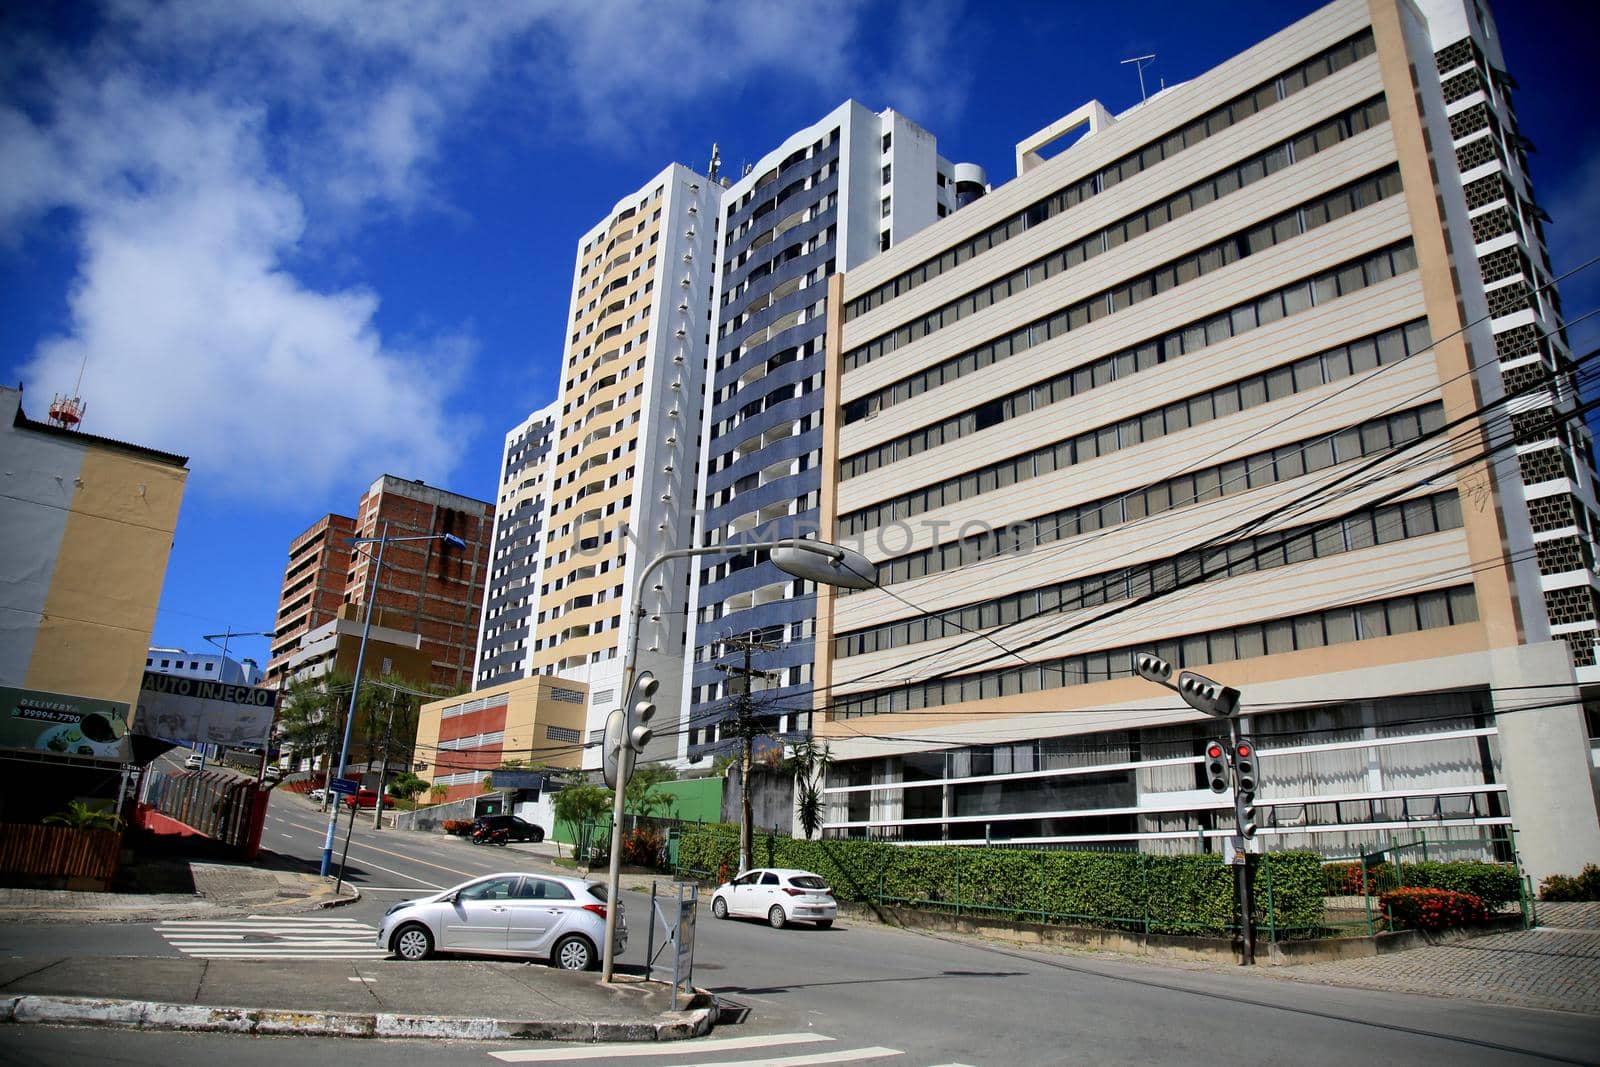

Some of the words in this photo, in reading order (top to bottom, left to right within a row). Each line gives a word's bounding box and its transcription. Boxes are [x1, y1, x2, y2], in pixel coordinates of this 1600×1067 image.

[144, 675, 191, 695] AUTO
[21, 699, 73, 711] DELIVERY
[24, 709, 81, 723] 99994-7790
